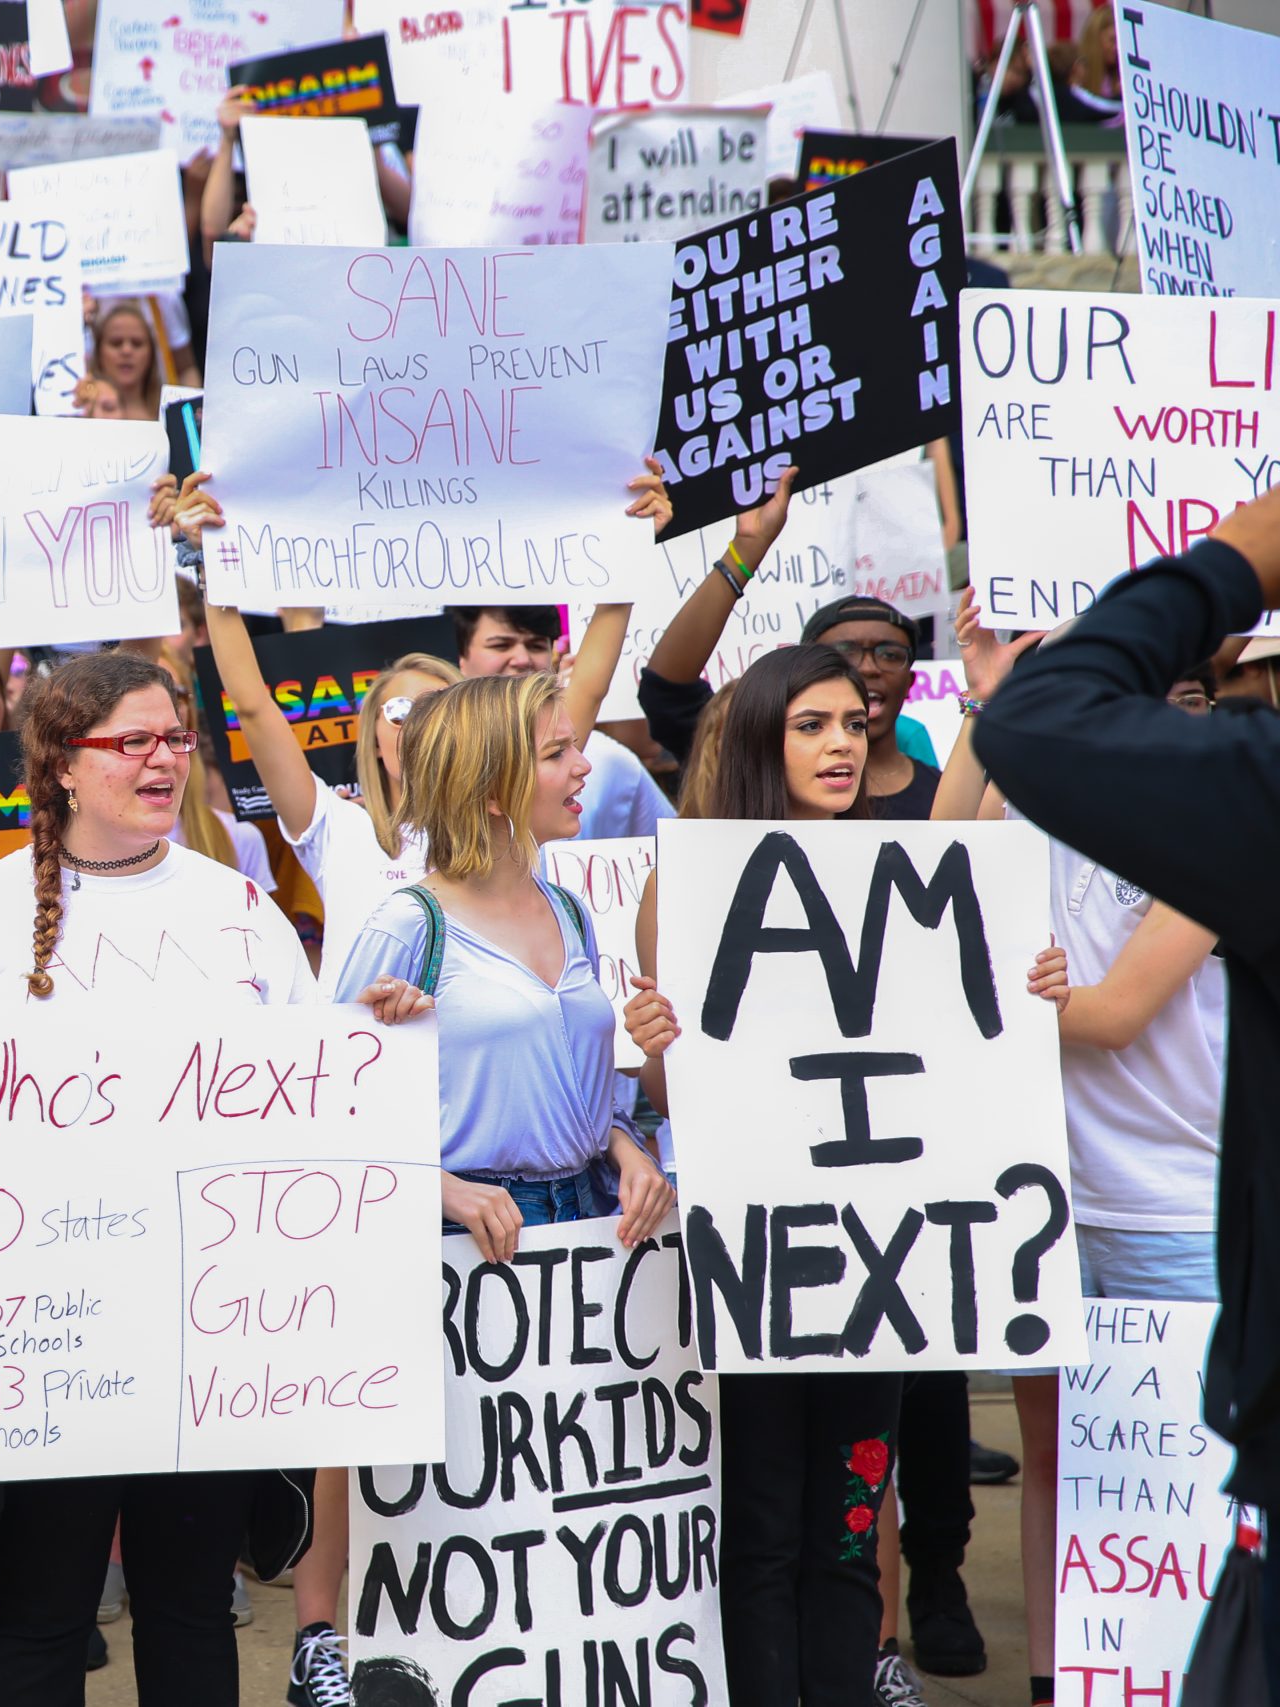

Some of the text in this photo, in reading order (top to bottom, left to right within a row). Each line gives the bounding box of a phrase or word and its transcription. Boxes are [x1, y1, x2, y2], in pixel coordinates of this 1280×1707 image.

[1122, 7, 1151, 71] I
[608, 126, 756, 171] I will be
[1132, 73, 1280, 166] SHOULDN'T
[1138, 124, 1177, 176] BE
[601, 175, 763, 224] attending
[1142, 174, 1234, 241] SCARED
[671, 192, 840, 290] OU'RE
[1142, 222, 1215, 284] WHEN
[346, 252, 535, 343] SANE
[666, 244, 845, 344] EITHER
[907, 176, 951, 412] AGAIN
[231, 339, 609, 387] GUN LAWS PREVENT
[684, 303, 812, 385] WITH
[972, 302, 1137, 385] OUR
[673, 344, 836, 433] US OR
[312, 386, 544, 470] INSANE
[653, 376, 862, 486] AGAINST
[977, 402, 1259, 449] ARE WORTH
[357, 472, 479, 511] KILLINGS
[730, 451, 793, 507] US
[1038, 456, 1156, 498] THAN
[23, 501, 168, 608] YOU
[755, 549, 805, 585] Will
[808, 545, 847, 588] Die
[1125, 499, 1251, 574] NR
[908, 668, 962, 704] RA
[295, 718, 355, 746] AT
[381, 868, 408, 881] OVE
[700, 829, 1004, 1042] AM
[158, 1030, 383, 1123] Next?
[789, 1051, 926, 1167] I
[199, 1165, 398, 1252] STOP
[189, 1264, 336, 1337] Gun
[685, 1162, 1070, 1371] NEXT?
[34, 1288, 102, 1323] Public
[443, 1231, 692, 1382] ROTECT
[43, 1369, 136, 1408] Private
[188, 1364, 400, 1427] Violence
[1131, 1366, 1162, 1400] A
[543, 1369, 712, 1494] KIDS
[1070, 1413, 1208, 1458] SCARES
[1062, 1475, 1195, 1518] THAN
[355, 1503, 718, 1640] NOT YOUR
[451, 1622, 709, 1707] GUNS
[1083, 1616, 1124, 1652] IN
